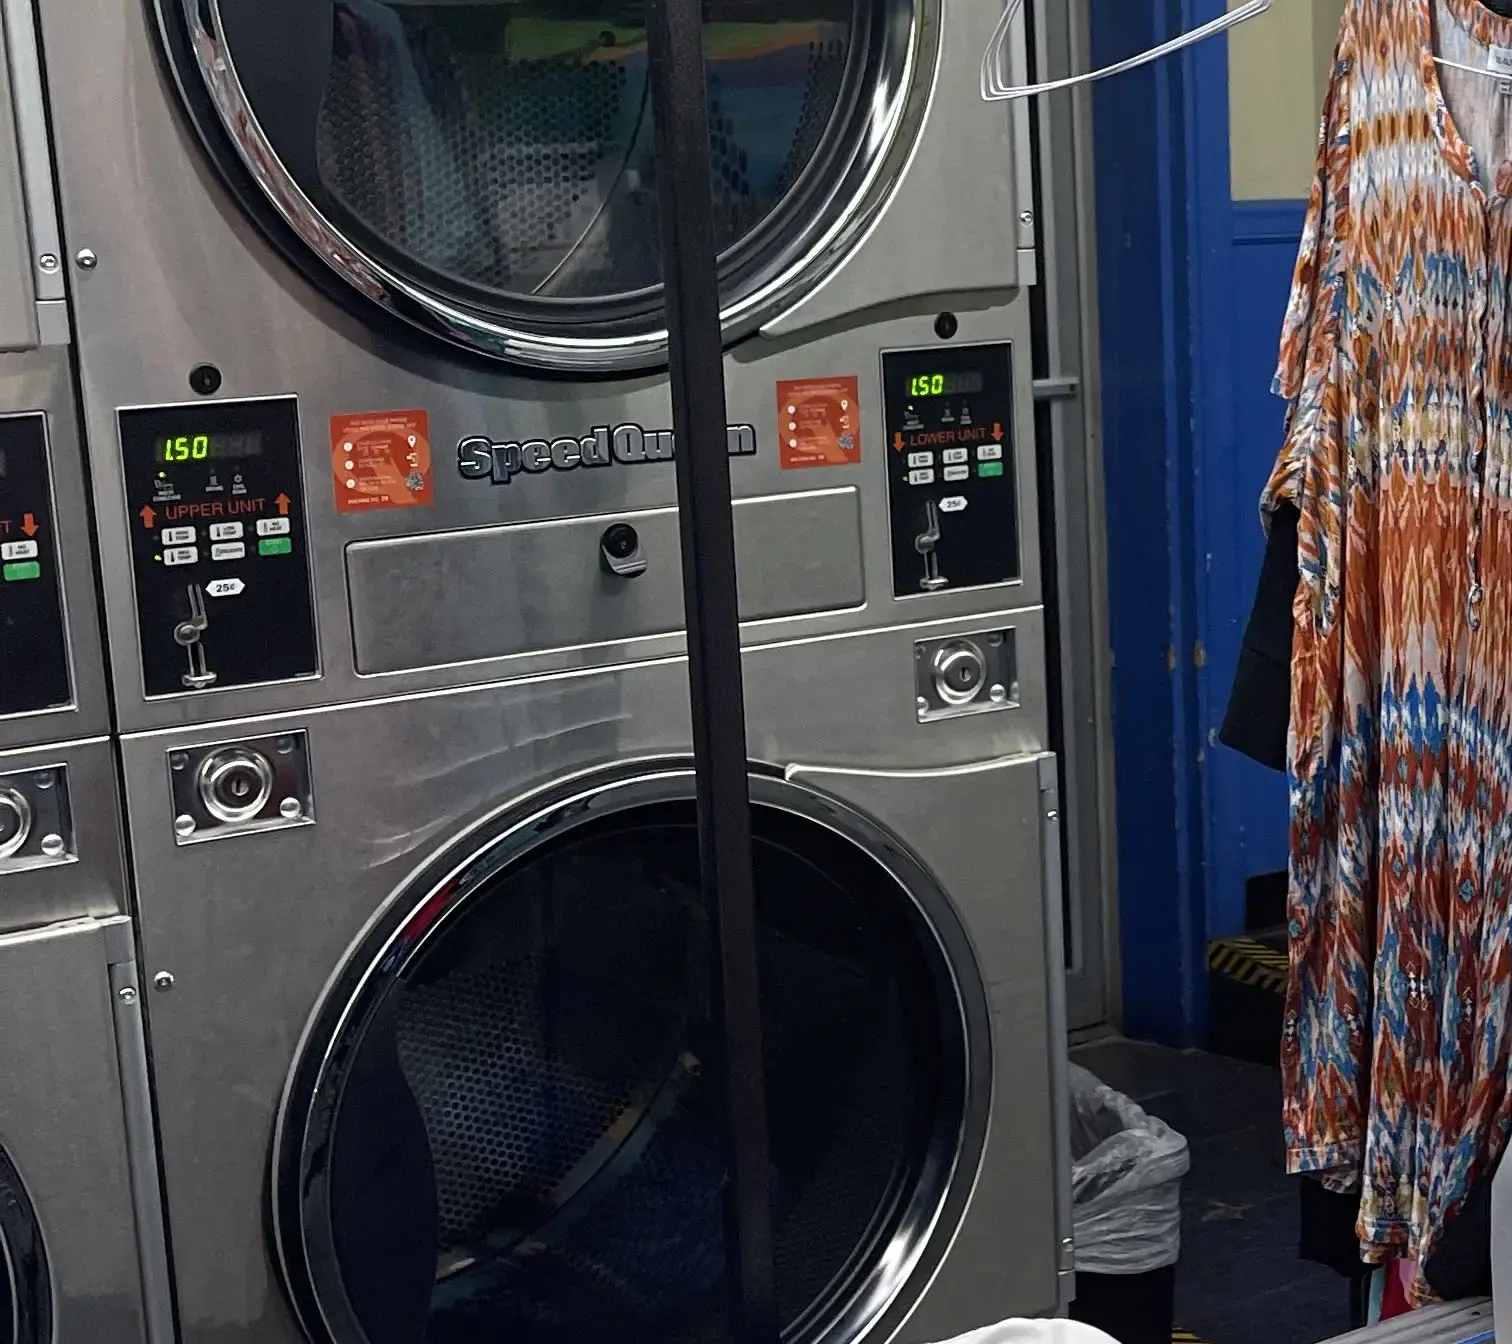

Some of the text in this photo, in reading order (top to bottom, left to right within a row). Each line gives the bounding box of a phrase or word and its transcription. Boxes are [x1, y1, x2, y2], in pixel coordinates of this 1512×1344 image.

[910, 427, 988, 447] LOWER UNIT
[165, 497, 266, 520] UPPER UNIT
[215, 582, 236, 594] 25¢
